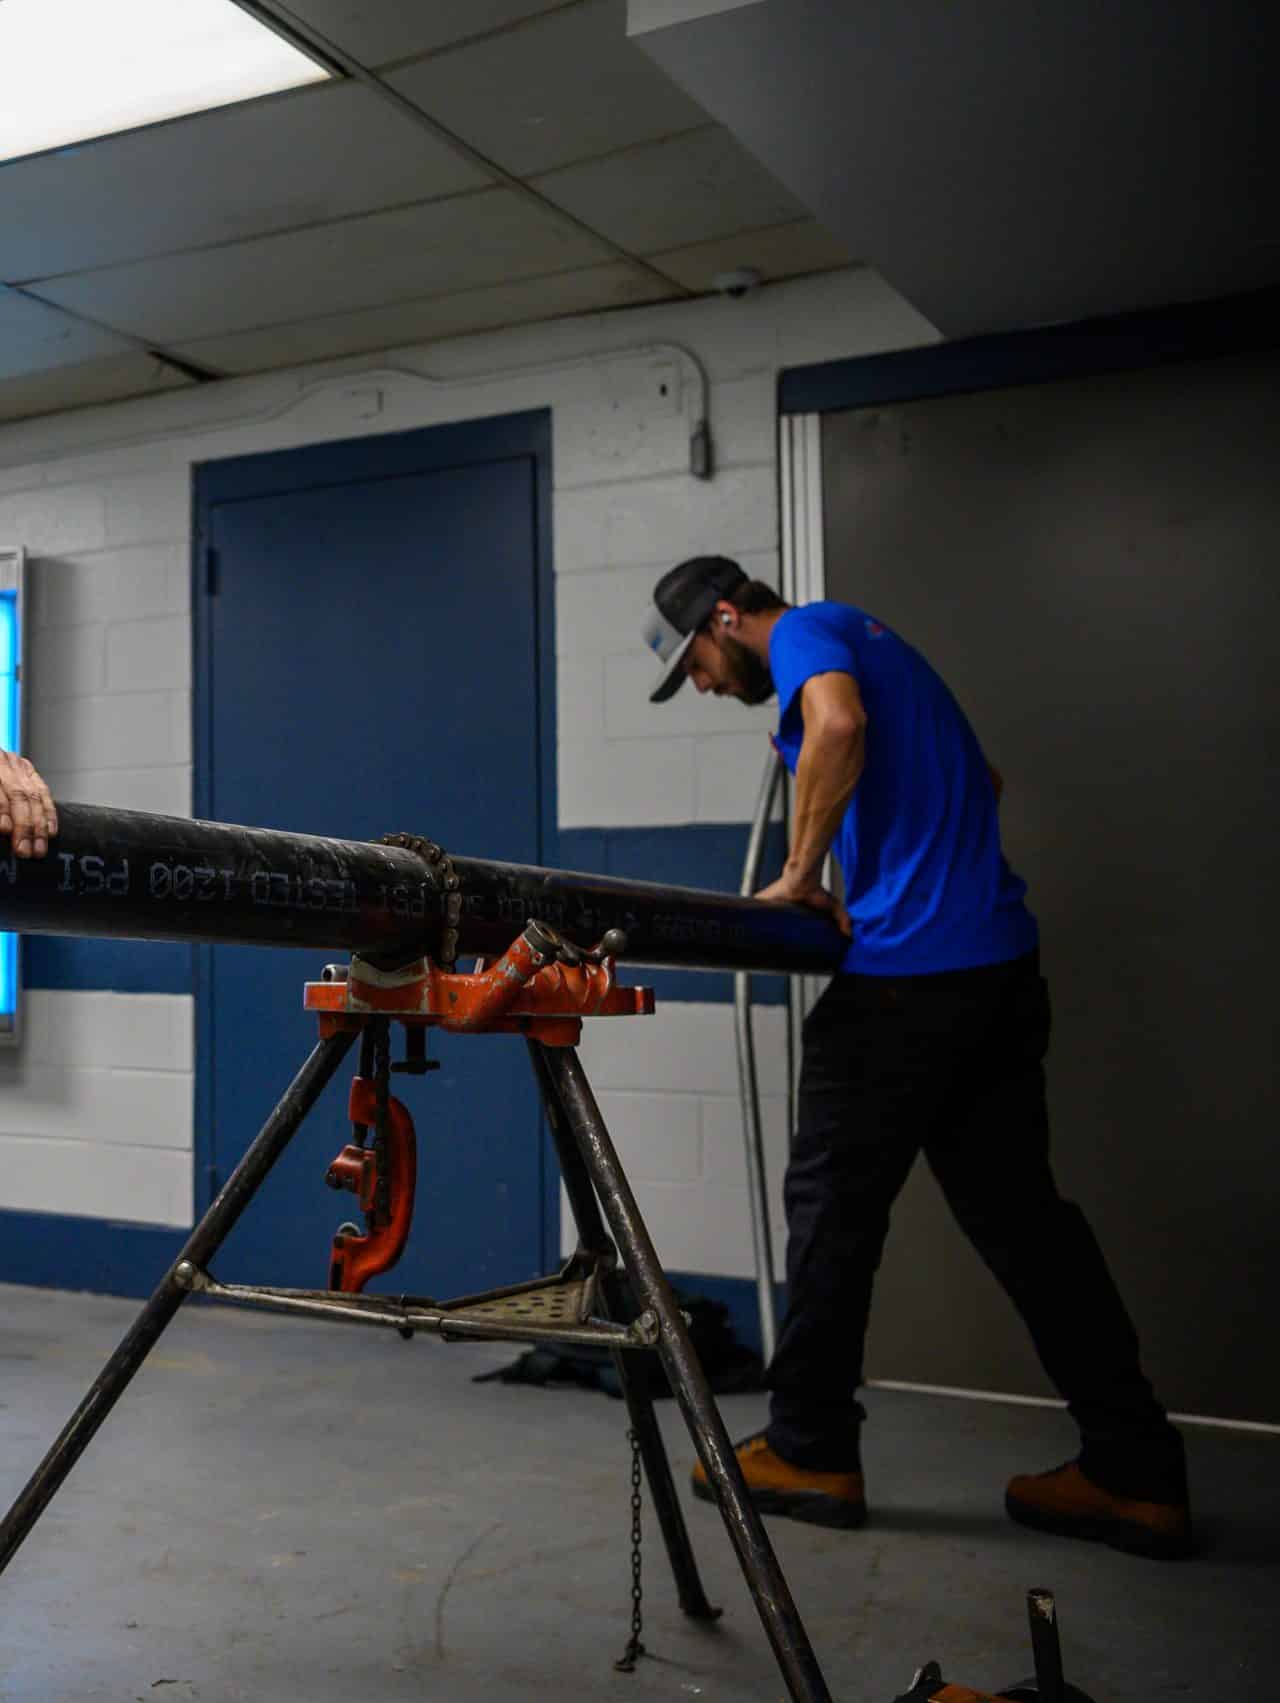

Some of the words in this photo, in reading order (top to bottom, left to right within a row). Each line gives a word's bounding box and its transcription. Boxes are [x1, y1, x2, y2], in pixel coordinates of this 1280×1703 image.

[57, 851, 130, 896] PSI
[149, 861, 235, 901] 1200
[250, 870, 361, 914] TESTED
